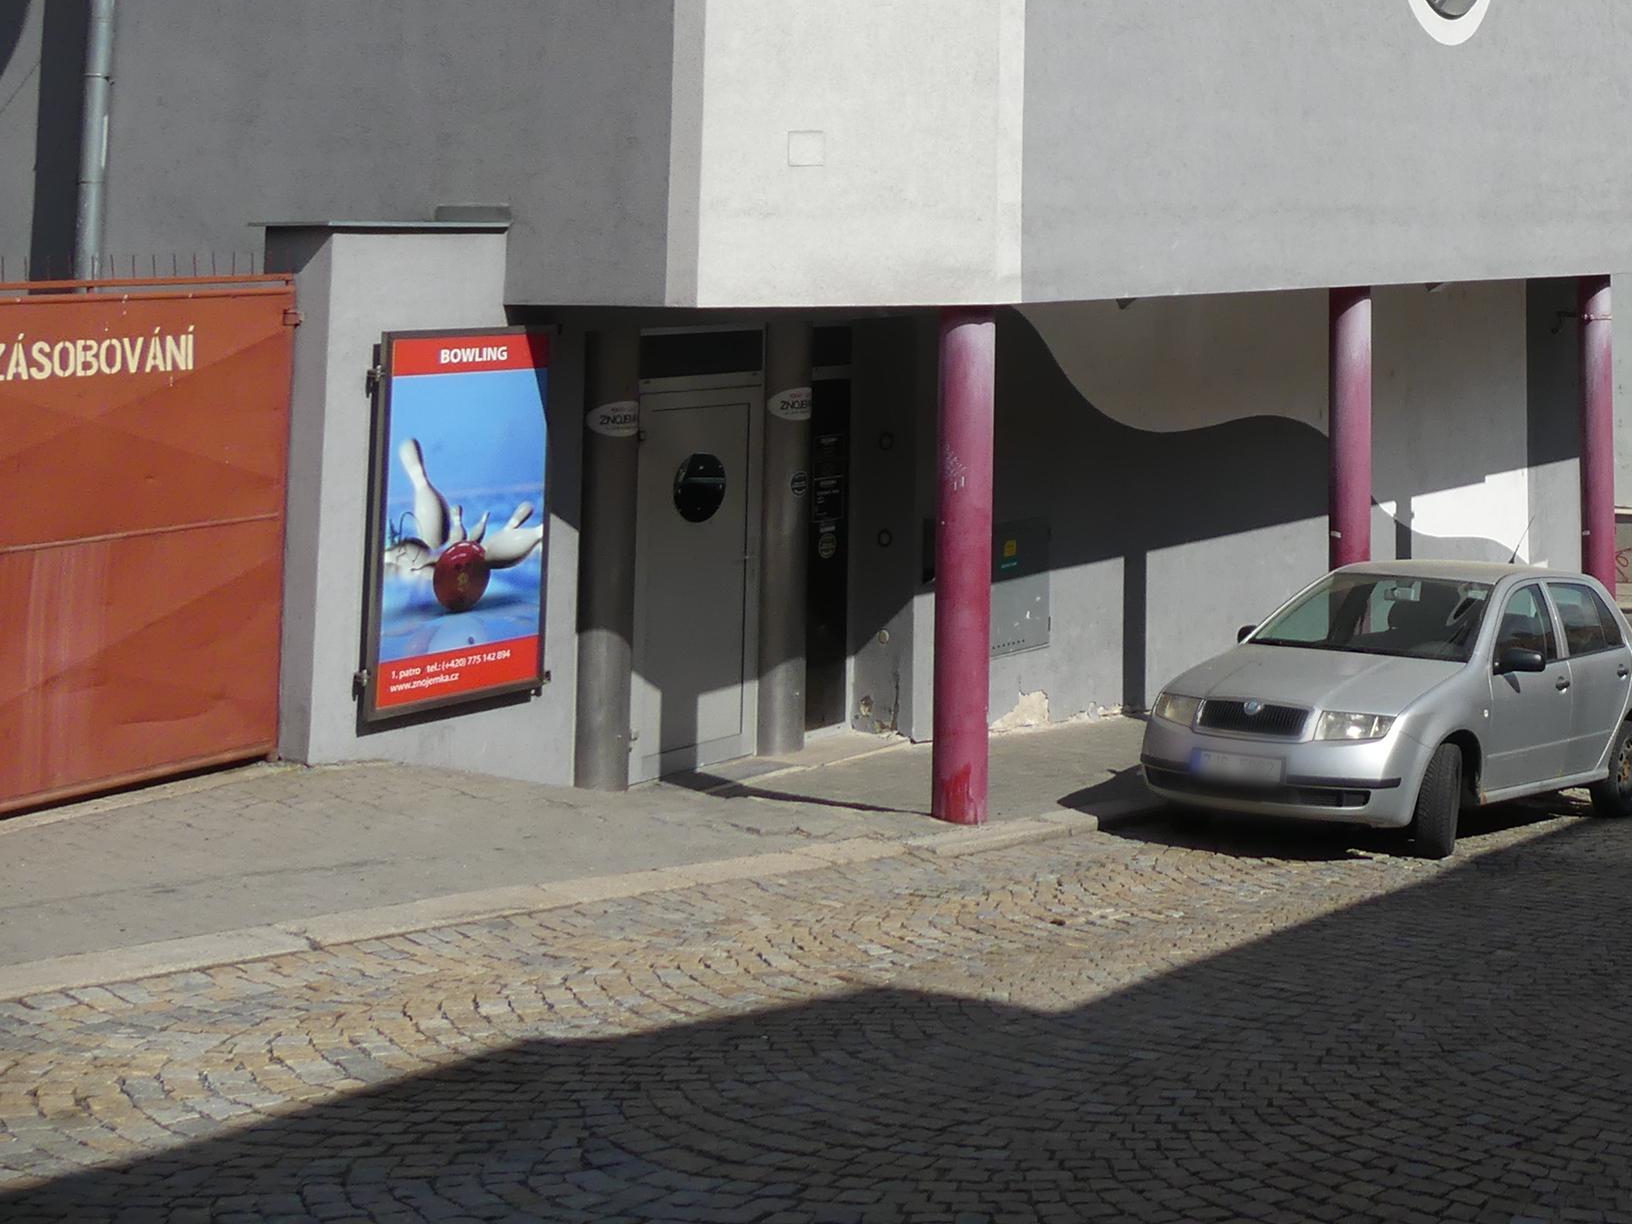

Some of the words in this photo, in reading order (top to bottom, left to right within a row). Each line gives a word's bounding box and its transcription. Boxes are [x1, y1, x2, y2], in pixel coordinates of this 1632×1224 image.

[440, 346, 508, 364] BOWLING
[391, 670, 398, 679] 1.
[399, 667, 421, 680] patro
[426, 663, 441, 673] tel.:
[441, 658, 466, 671] (+420)
[467, 654, 481, 665] 775
[483, 652, 495, 663] 142
[497, 649, 511, 659] 894
[390, 673, 459, 692] www.znojemka.cz
